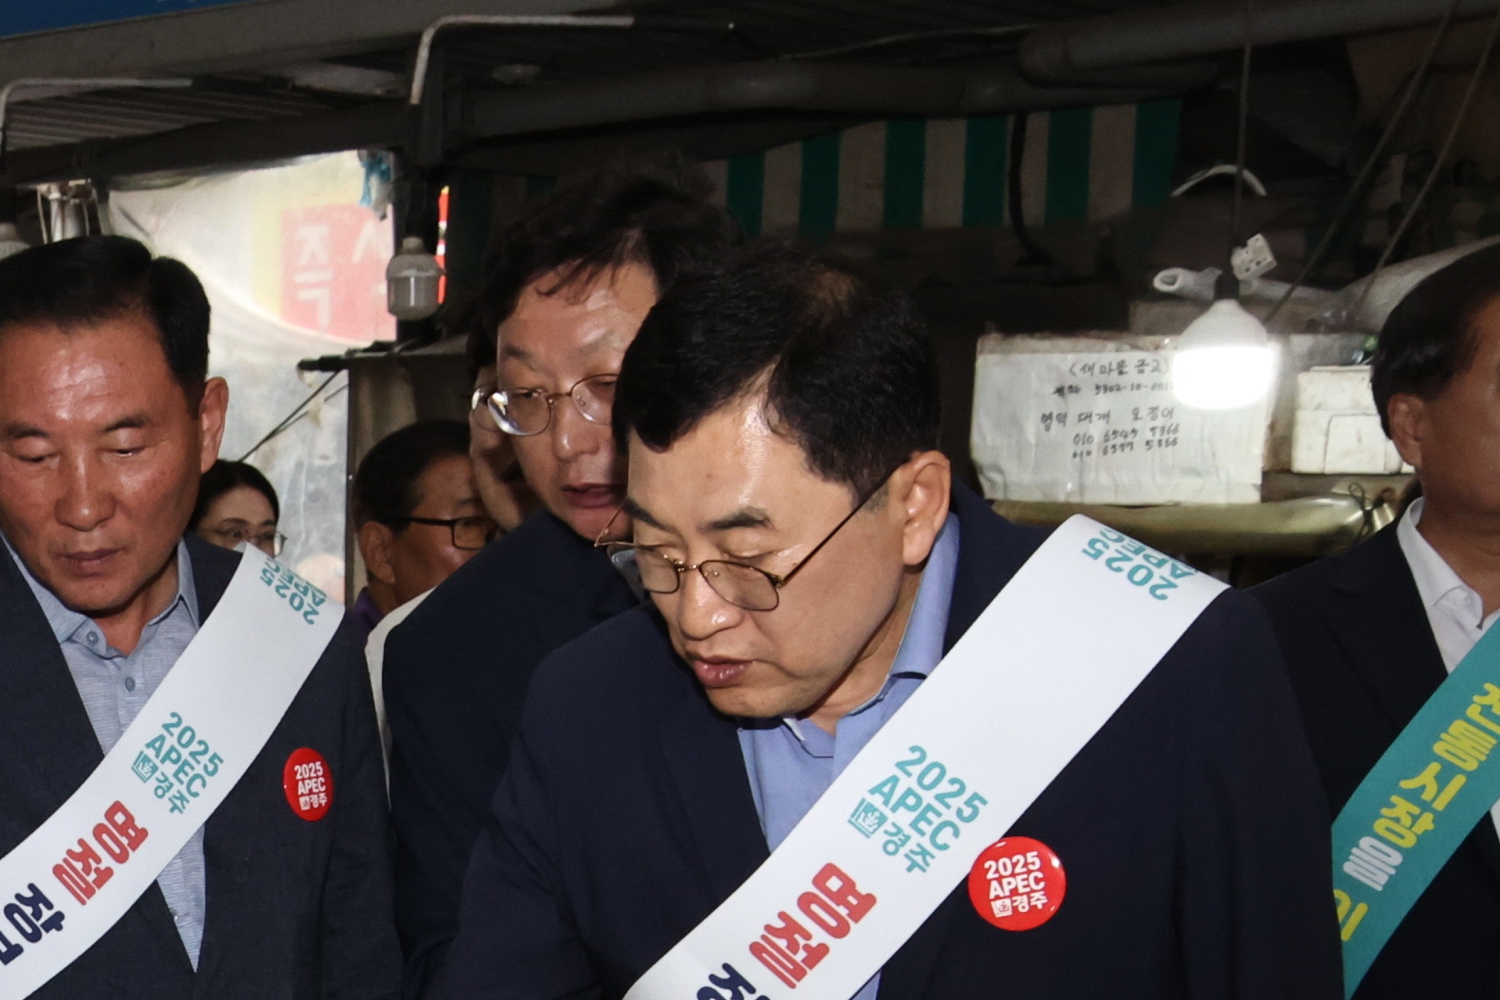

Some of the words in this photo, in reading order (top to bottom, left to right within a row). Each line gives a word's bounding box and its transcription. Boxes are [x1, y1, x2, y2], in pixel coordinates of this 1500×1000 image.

[146, 735, 207, 798] APEC
[163, 713, 224, 777] 2025
[294, 761, 324, 779] 2025
[296, 778, 327, 796] APEC
[896, 746, 988, 823] 2025
[155, 775, 188, 813] 경주
[310, 794, 328, 811] 경주
[870, 776, 960, 851] APEC
[53, 801, 149, 905] 명절
[884, 824, 935, 873] 경주
[984, 852, 1041, 879] 2025
[987, 871, 1045, 898] APEC
[1012, 893, 1048, 915] 경주
[750, 863, 877, 989] 명절
